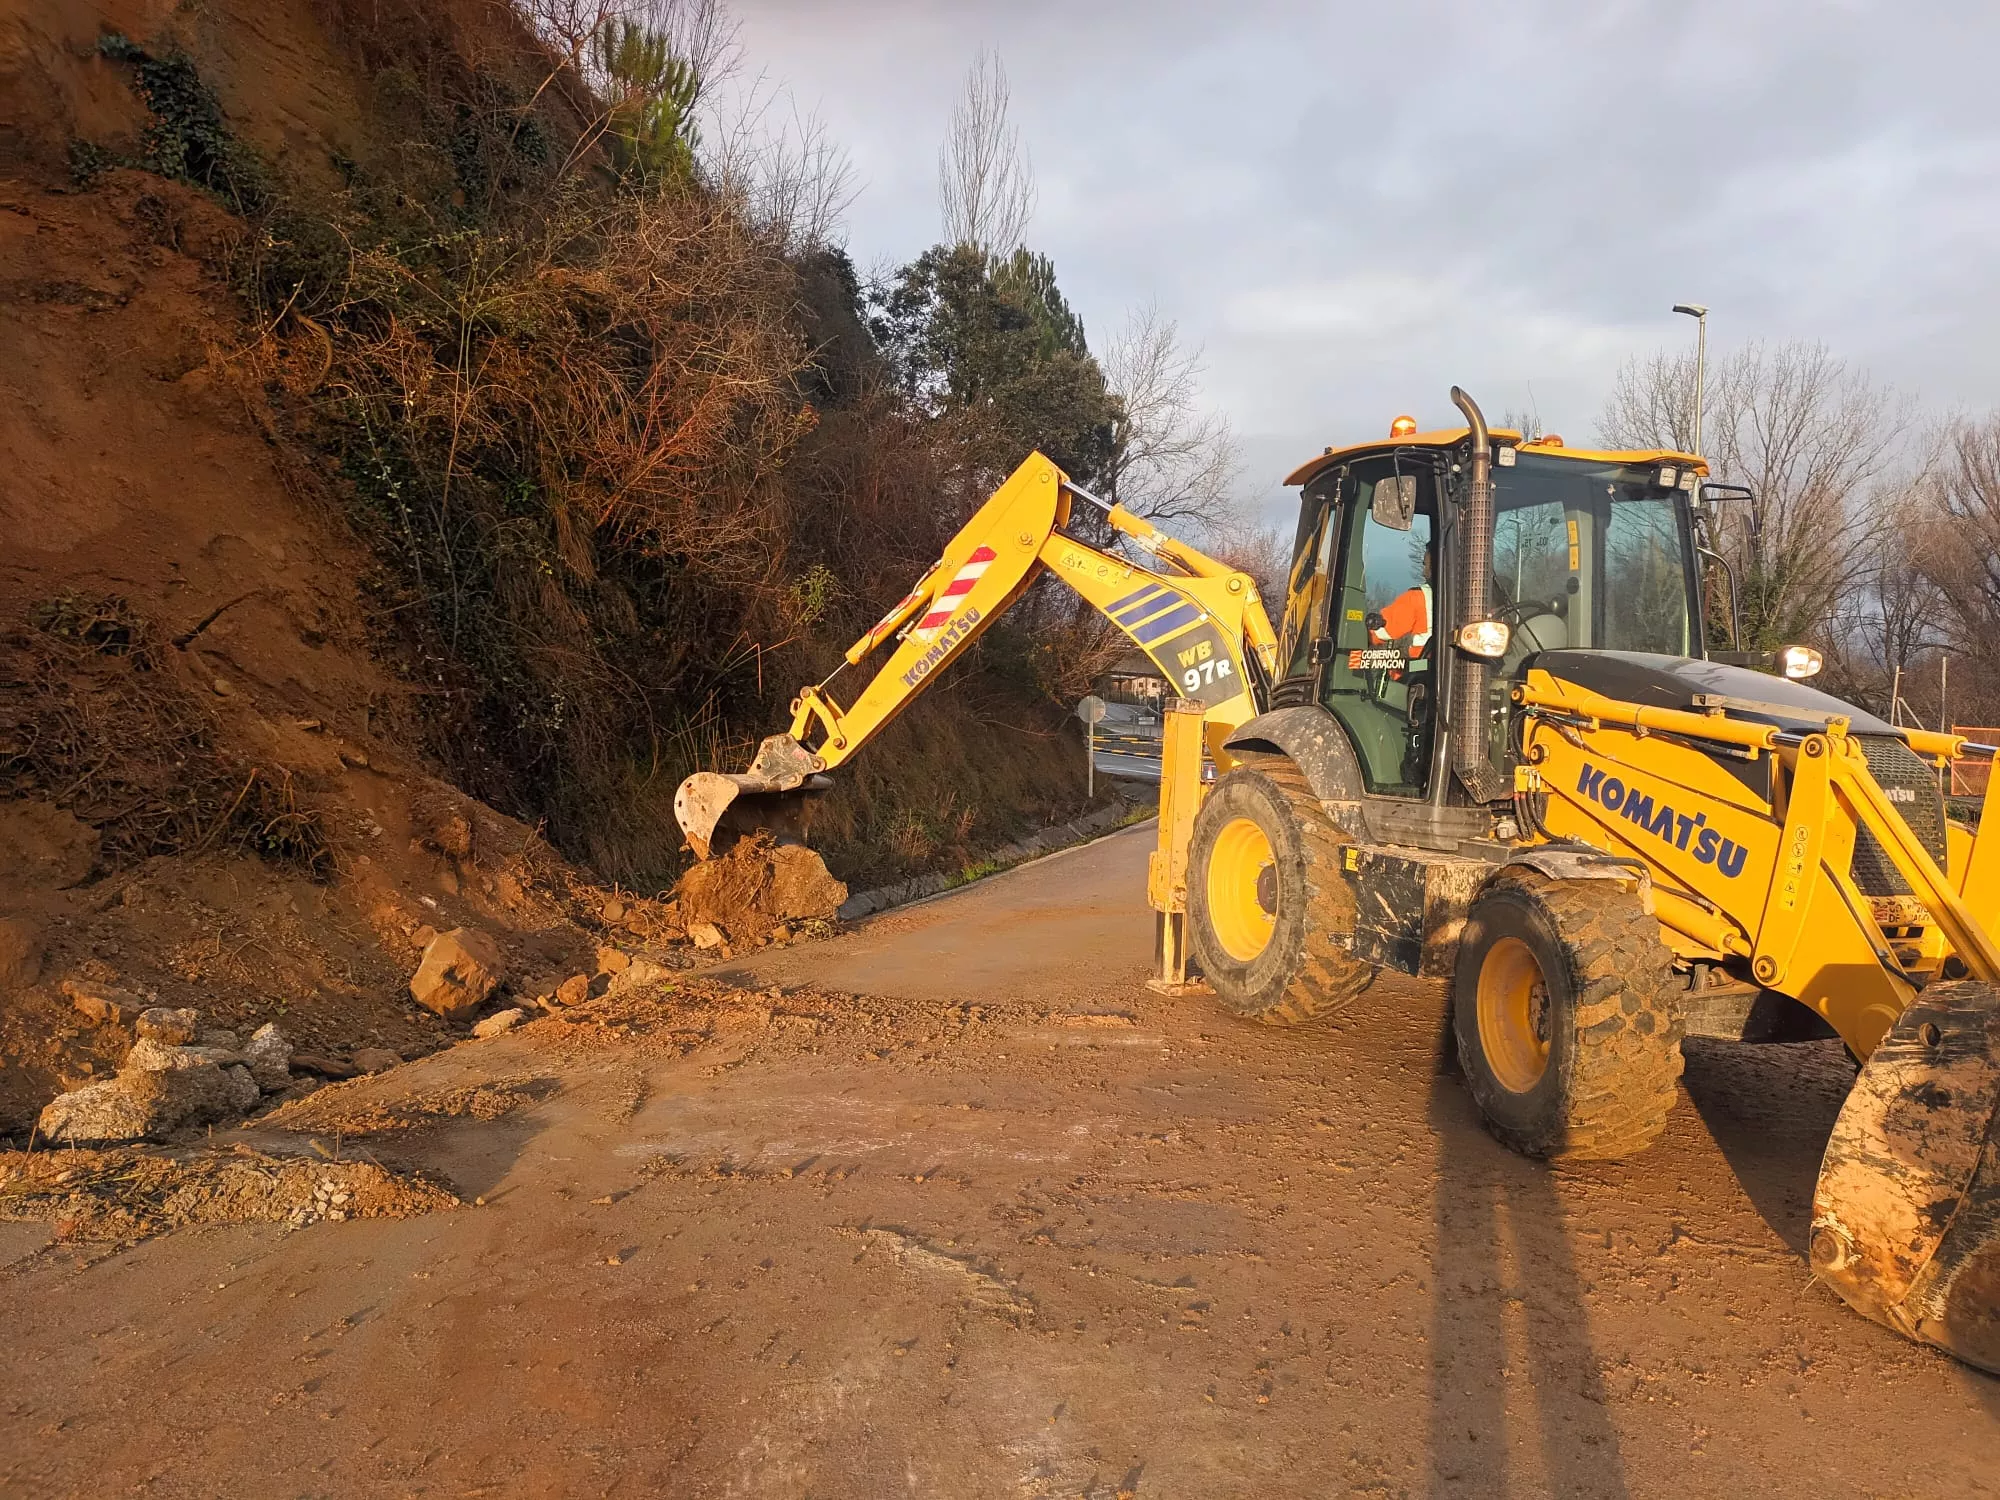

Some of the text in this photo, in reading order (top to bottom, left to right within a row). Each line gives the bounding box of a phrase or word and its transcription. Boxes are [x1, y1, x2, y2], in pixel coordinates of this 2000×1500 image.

[902, 606, 981, 687] KOMATSU
[1177, 640, 1213, 668] WB
[1361, 649, 1400, 660] GOBIERNO
[1184, 659, 1234, 692] 97R
[1360, 659, 1405, 669] DE ARAGON
[1884, 785, 1915, 802] ATSU
[1576, 763, 1748, 878] KOMATSU
